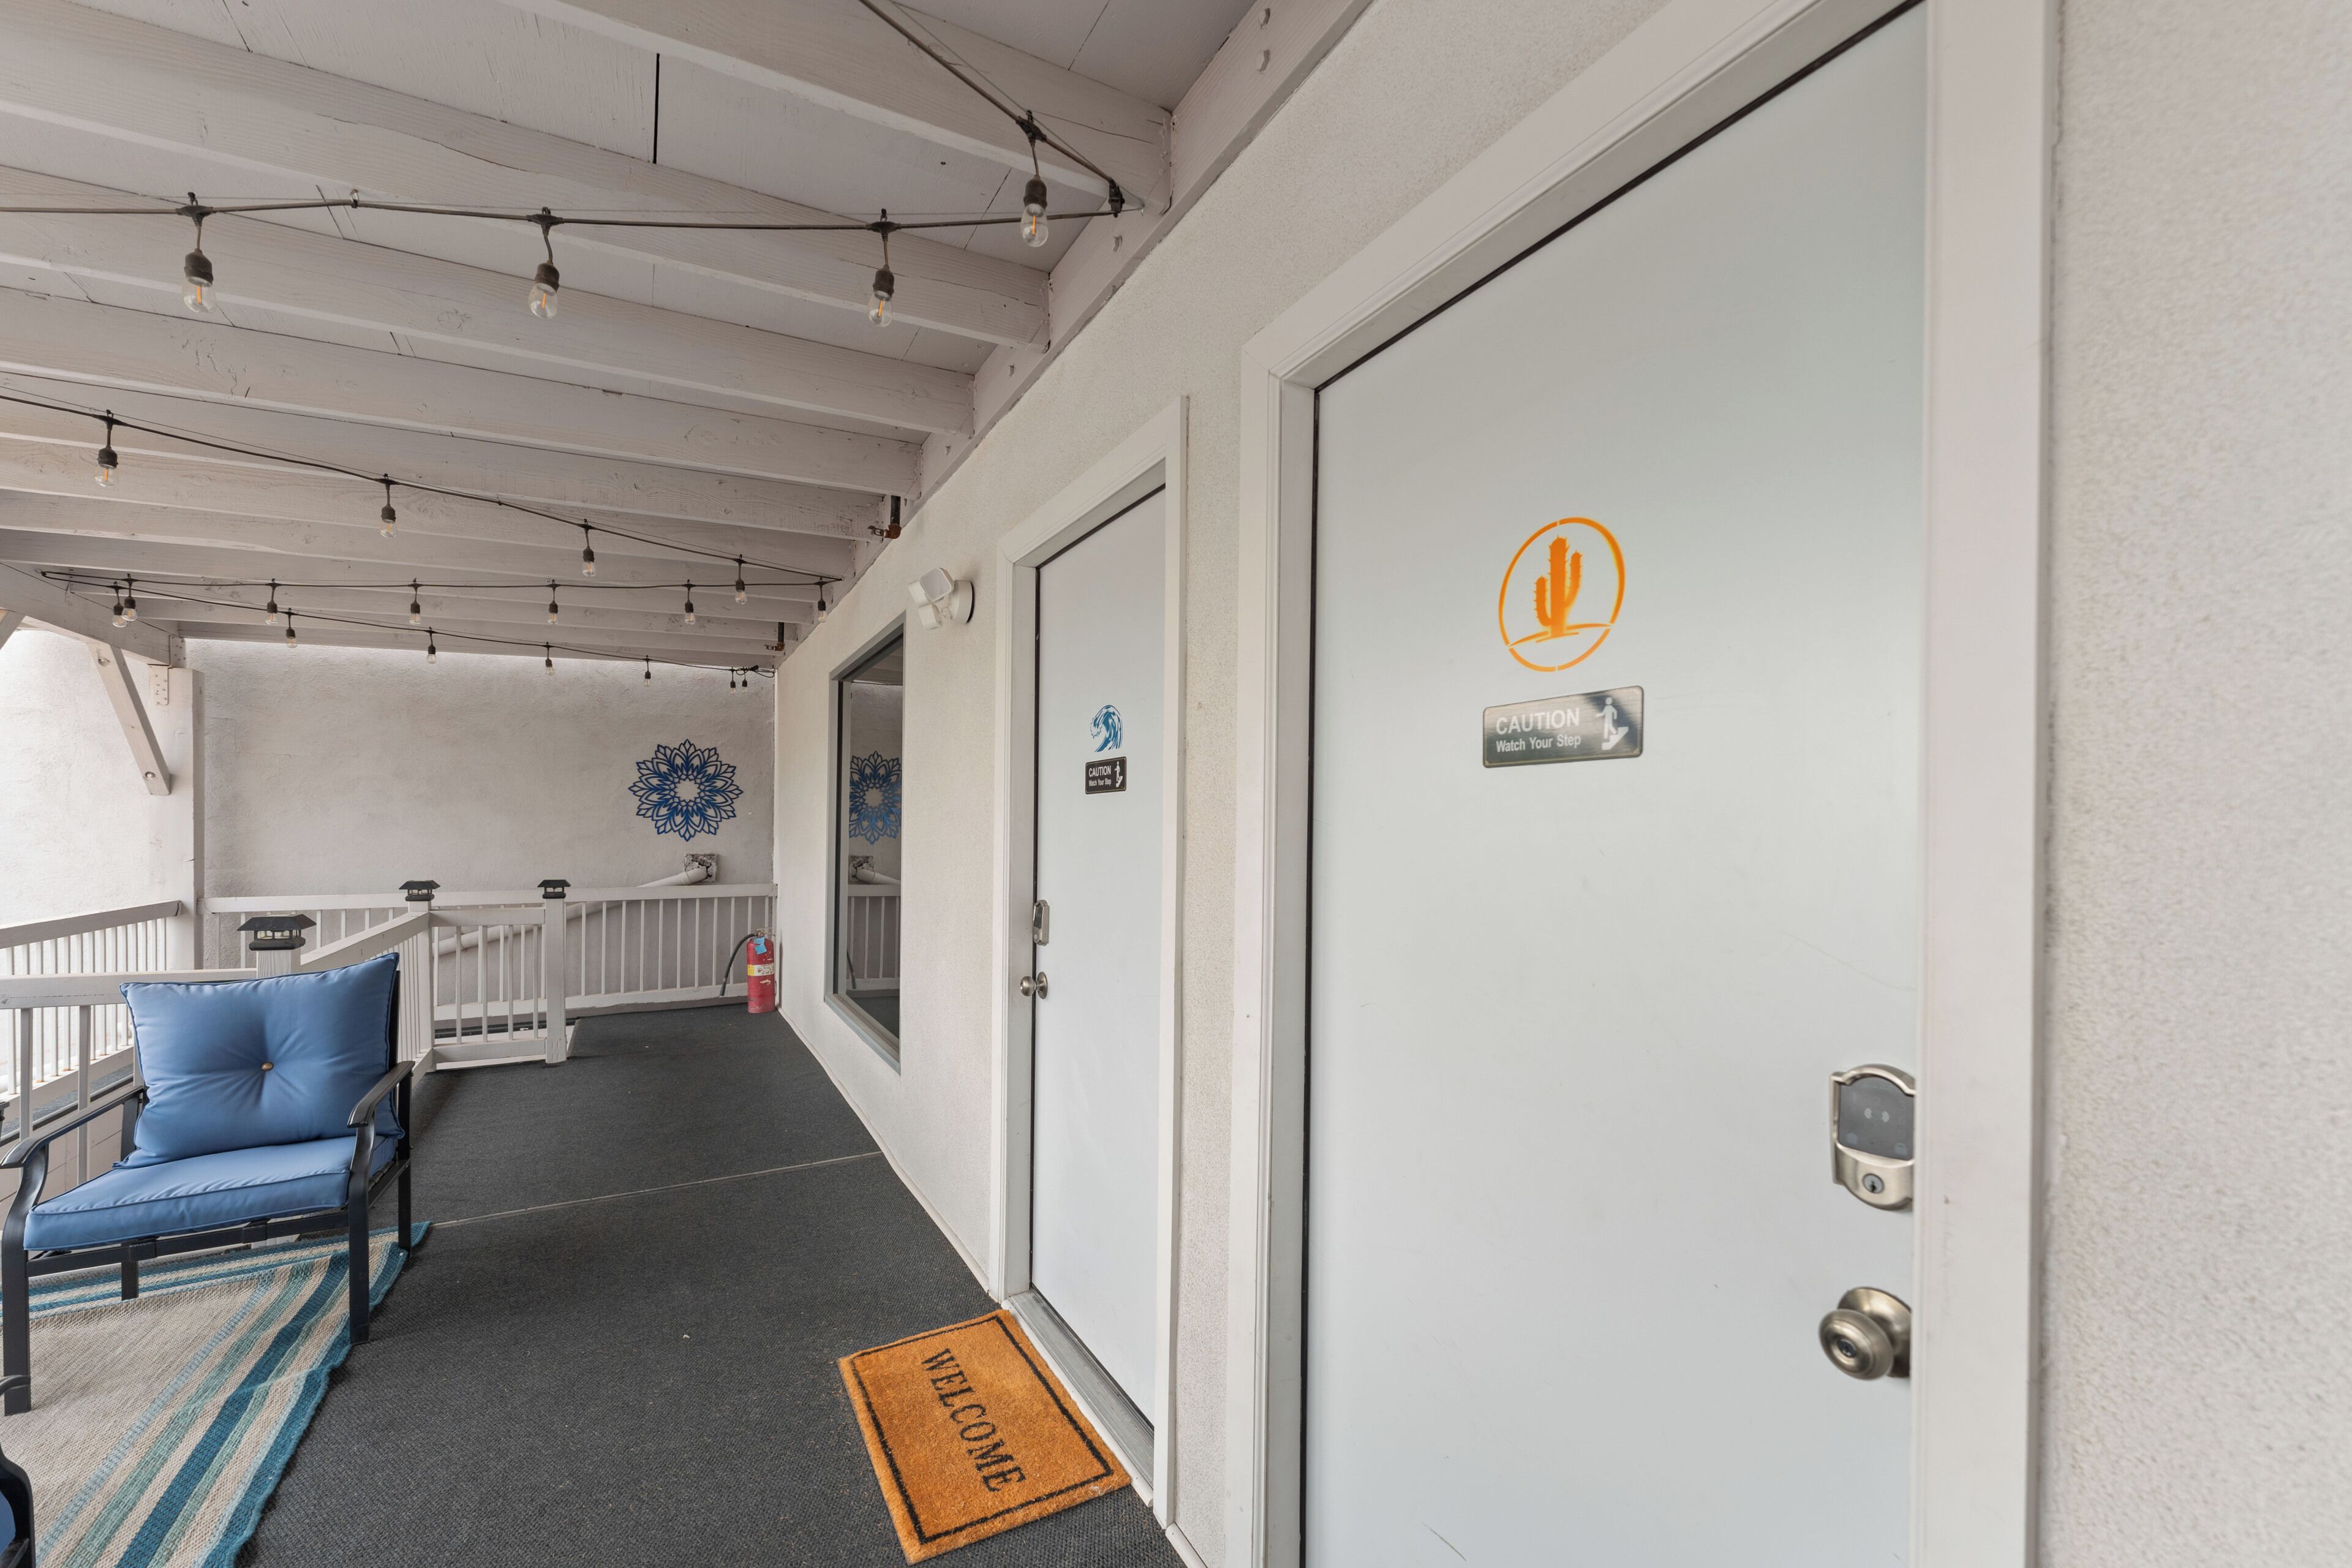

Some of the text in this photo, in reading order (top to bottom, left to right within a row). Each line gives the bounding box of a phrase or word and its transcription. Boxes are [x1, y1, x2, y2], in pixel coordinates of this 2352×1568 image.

[1496, 708, 1580, 734] CAUTION
[1496, 734, 1581, 752] Watch Your Step
[1088, 766, 1111, 777] CAUTION
[921, 1348, 1026, 1492] WELCOME
